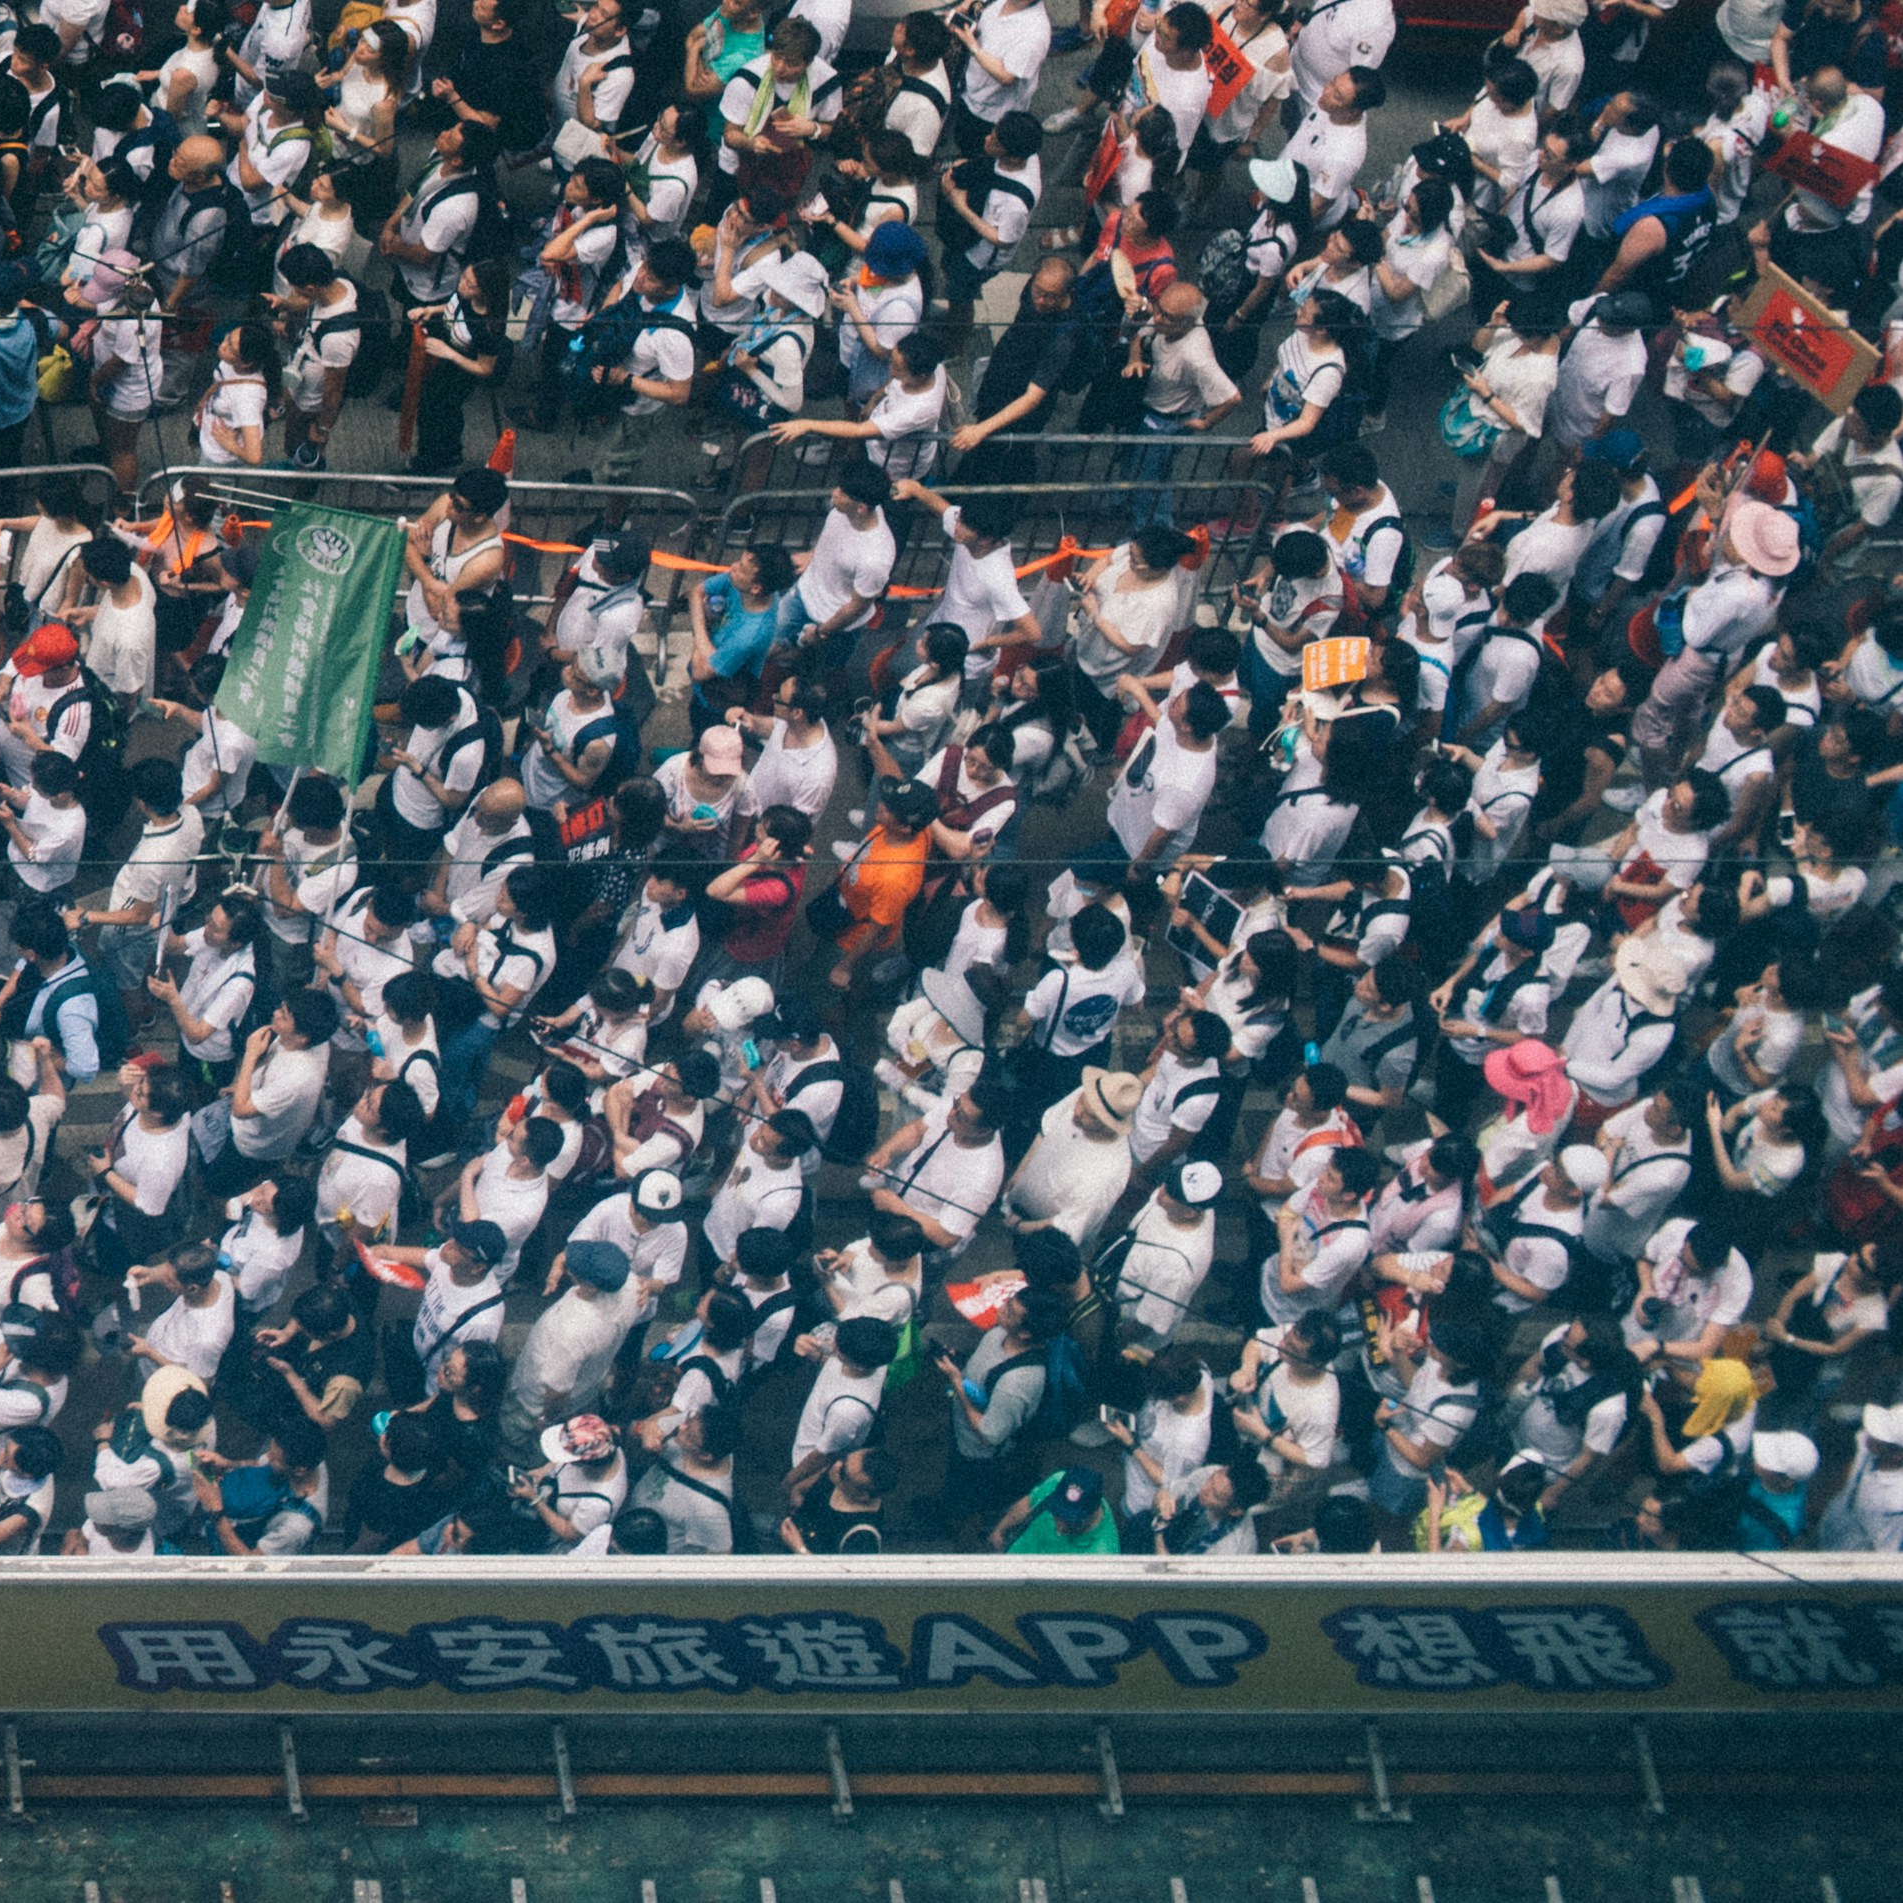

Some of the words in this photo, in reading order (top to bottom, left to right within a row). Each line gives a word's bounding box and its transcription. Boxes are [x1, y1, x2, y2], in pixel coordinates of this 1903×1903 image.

[118, 1613, 1253, 1694] 用永安旅遊APP
[1338, 1612, 1658, 1686] 想飛
[1715, 1606, 1903, 1686] 就
